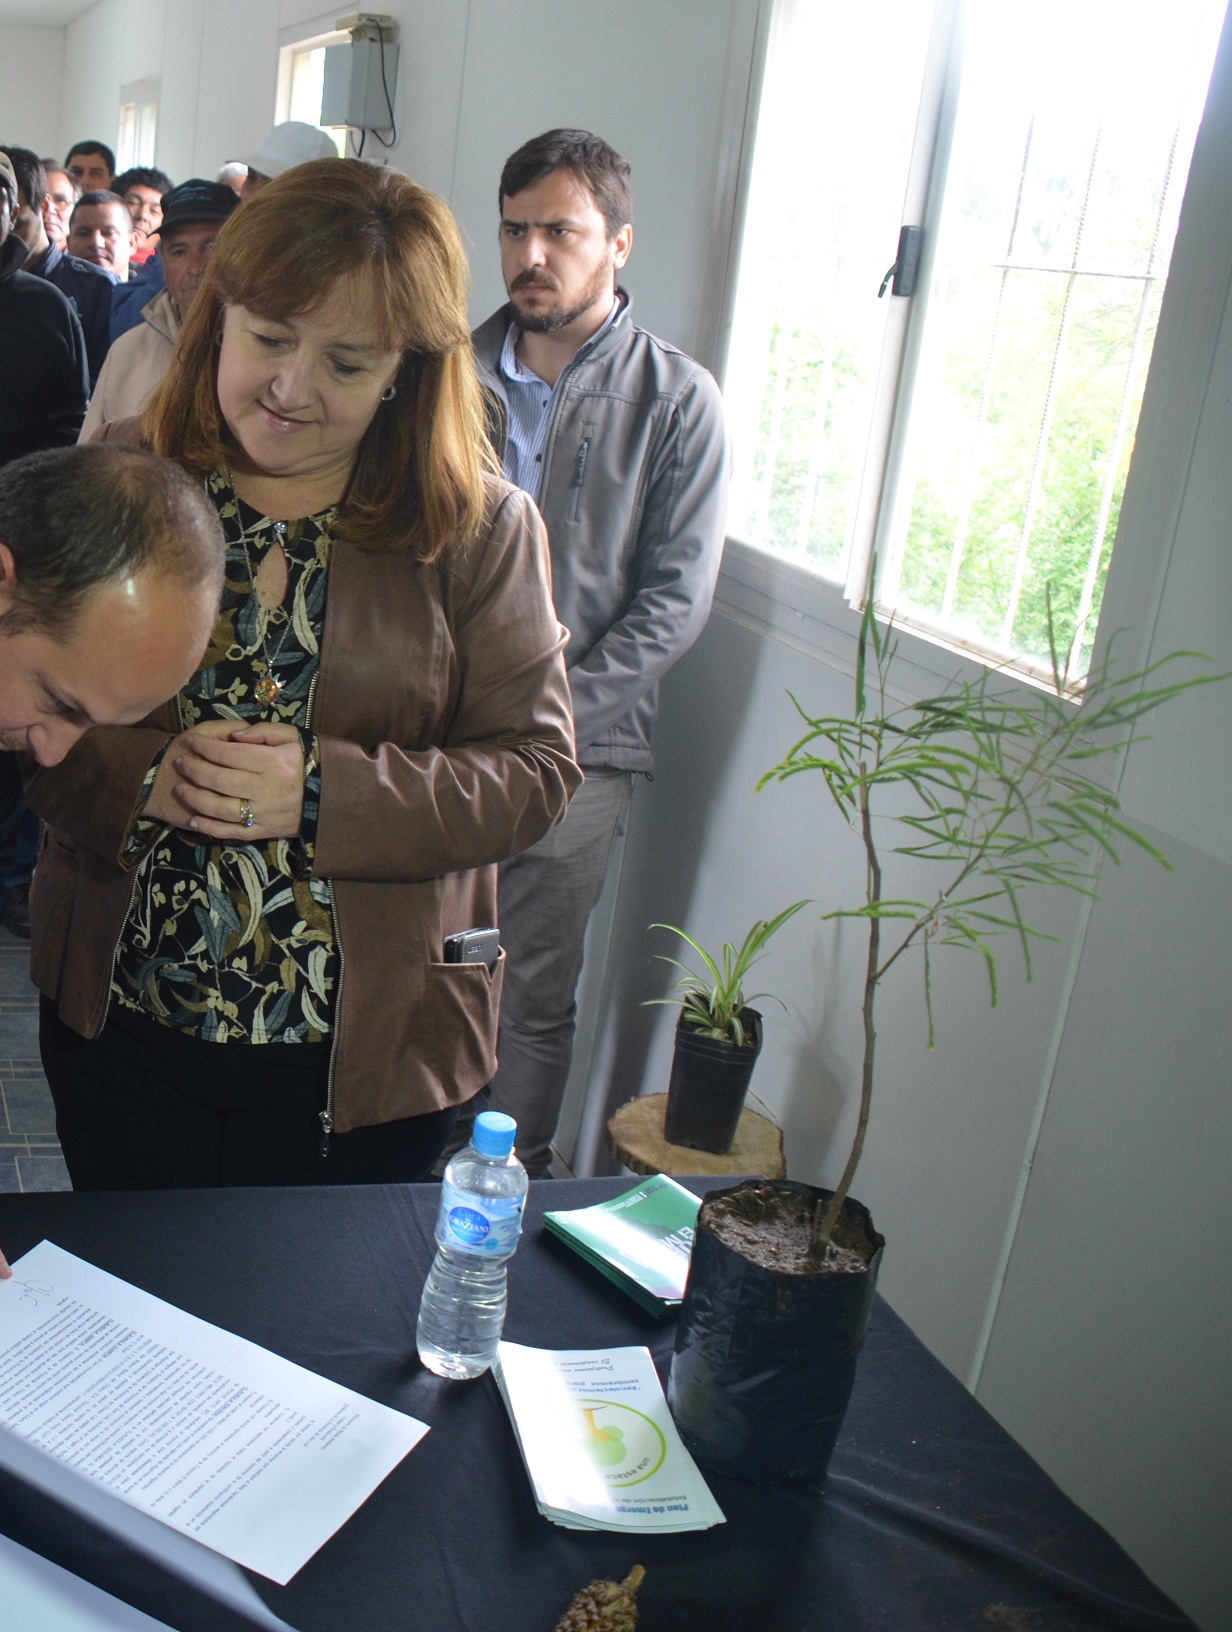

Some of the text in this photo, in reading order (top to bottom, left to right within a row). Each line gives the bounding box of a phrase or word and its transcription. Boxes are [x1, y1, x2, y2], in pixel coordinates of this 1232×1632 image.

[605, 1457, 650, 1479] una estaca
[633, 1495, 687, 1503] Estabilización
[666, 1503, 689, 1511] Plan
